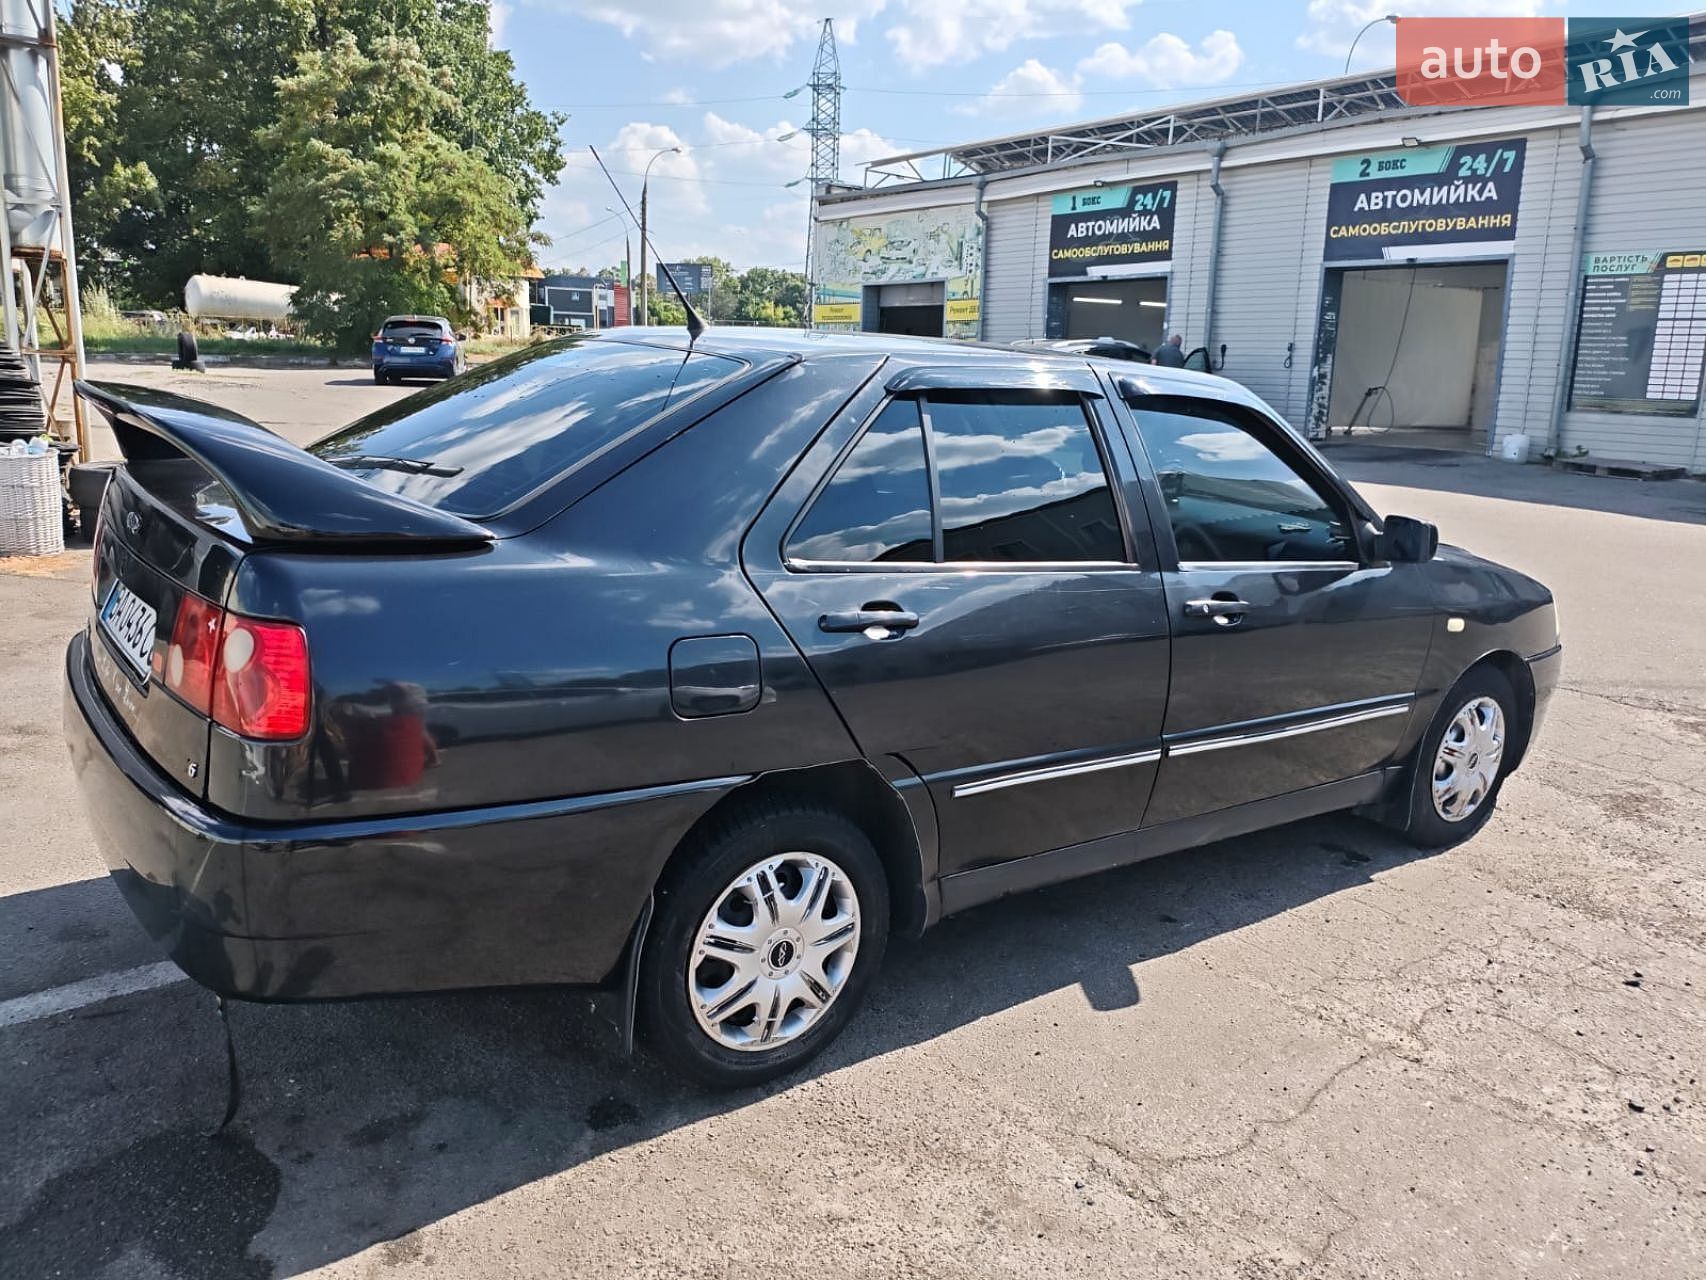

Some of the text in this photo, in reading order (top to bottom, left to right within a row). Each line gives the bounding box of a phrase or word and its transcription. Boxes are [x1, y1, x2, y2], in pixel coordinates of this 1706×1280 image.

[1359, 158, 1407, 178] 2 БОКС
[1458, 149, 1516, 177] 24/7
[1071, 195, 1077, 211] 1
[1134, 189, 1172, 212] 24/7
[1353, 180, 1498, 212] АВТОМИЙКА
[1067, 213, 1161, 238] АВТОМИЙКА
[1329, 213, 1512, 238] САМООБСЛУГОВУВАННЯ
[1051, 240, 1170, 259] САМООБСЛУГОВУВАННЯ
[1594, 255, 1648, 264] ВАРТІСТЬ
[1592, 263, 1637, 273] ПОСЛУГ
